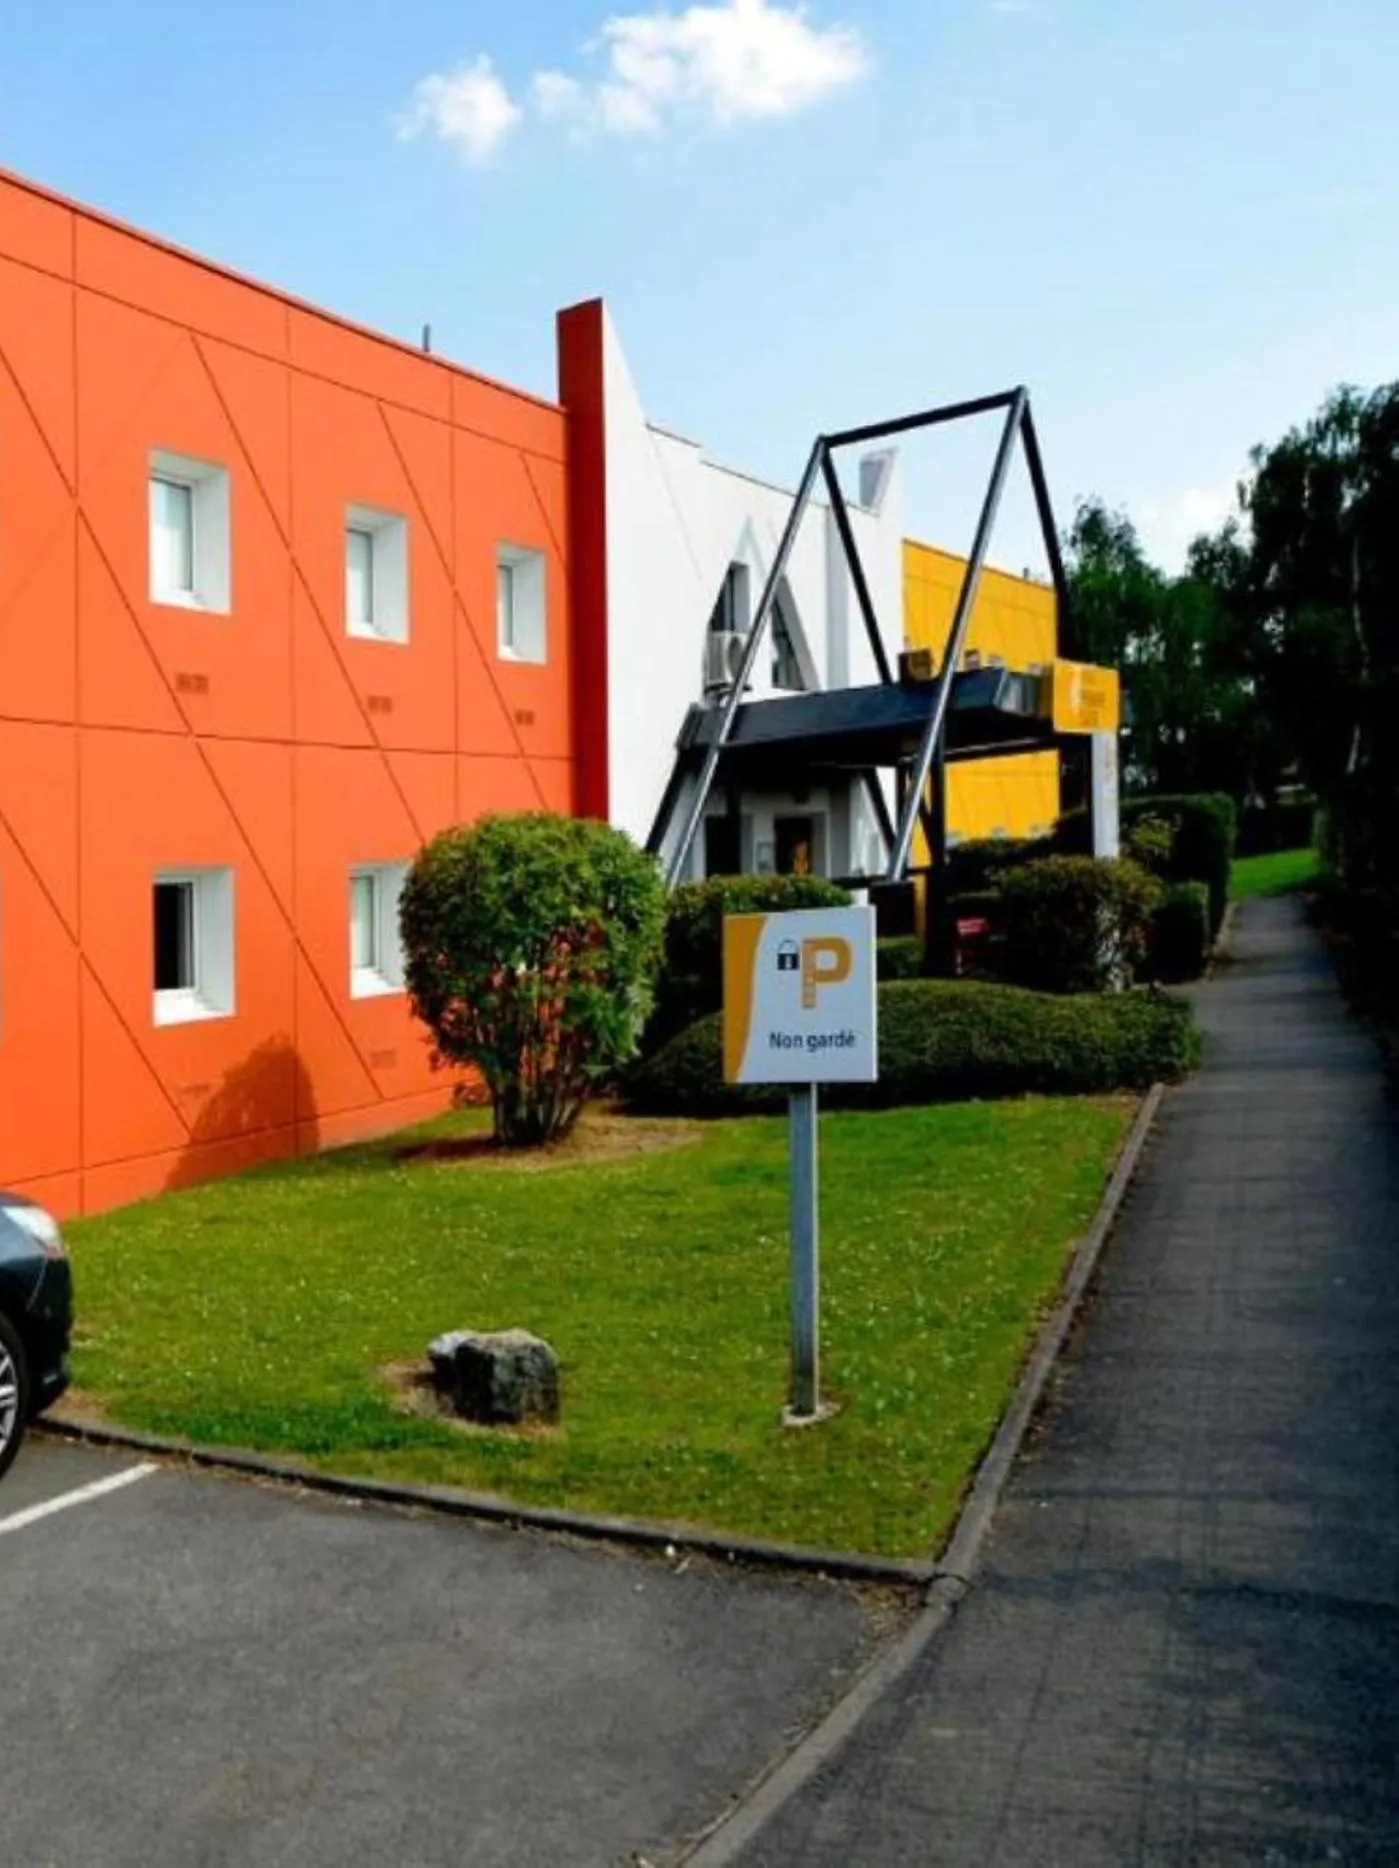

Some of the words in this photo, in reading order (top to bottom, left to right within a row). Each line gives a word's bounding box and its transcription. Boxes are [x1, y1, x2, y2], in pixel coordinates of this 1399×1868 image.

[802, 938, 851, 1009] P
[769, 1031, 803, 1049] Non
[807, 1029, 855, 1052] gardé
